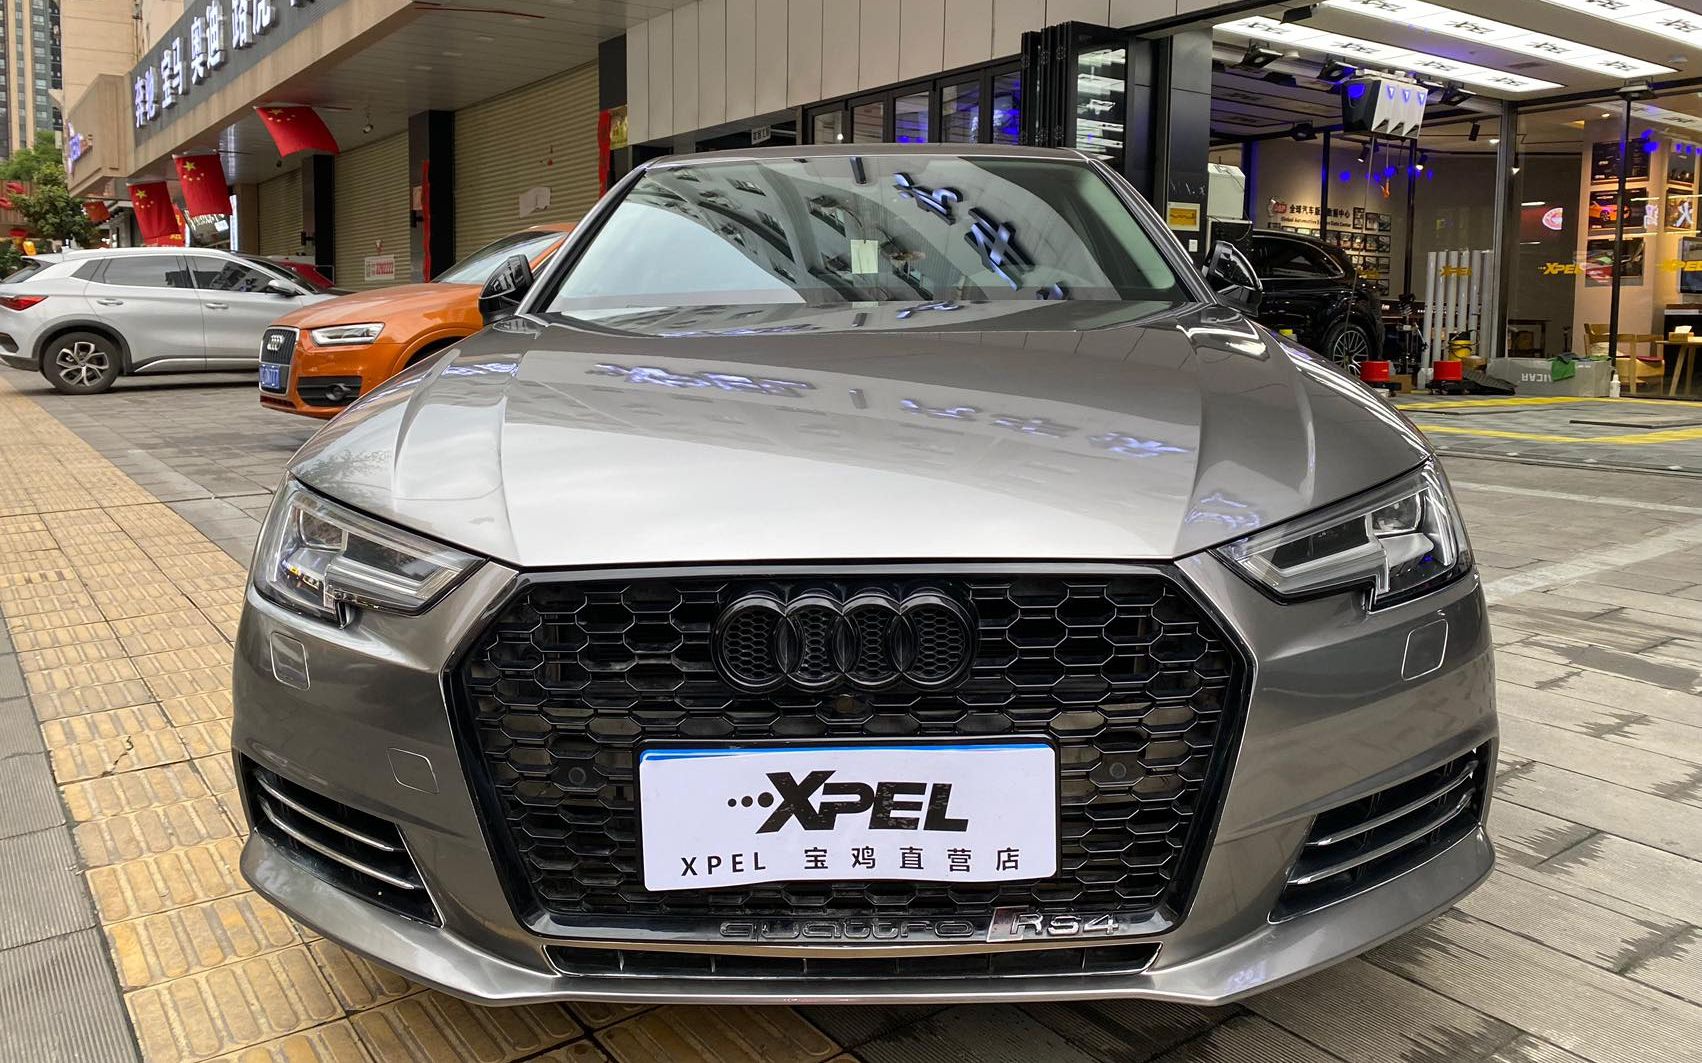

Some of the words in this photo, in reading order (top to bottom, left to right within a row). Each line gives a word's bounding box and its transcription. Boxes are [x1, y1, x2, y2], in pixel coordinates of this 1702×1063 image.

[161, 37, 186, 108] 宝马
[191, 0, 225, 84] 奥迪
[756, 770, 968, 834] XPEL
[681, 851, 766, 877] XPEL
[804, 846, 1020, 873] 宝鸡直营店
[720, 918, 975, 941] quattro
[1010, 912, 1120, 937] RS4
